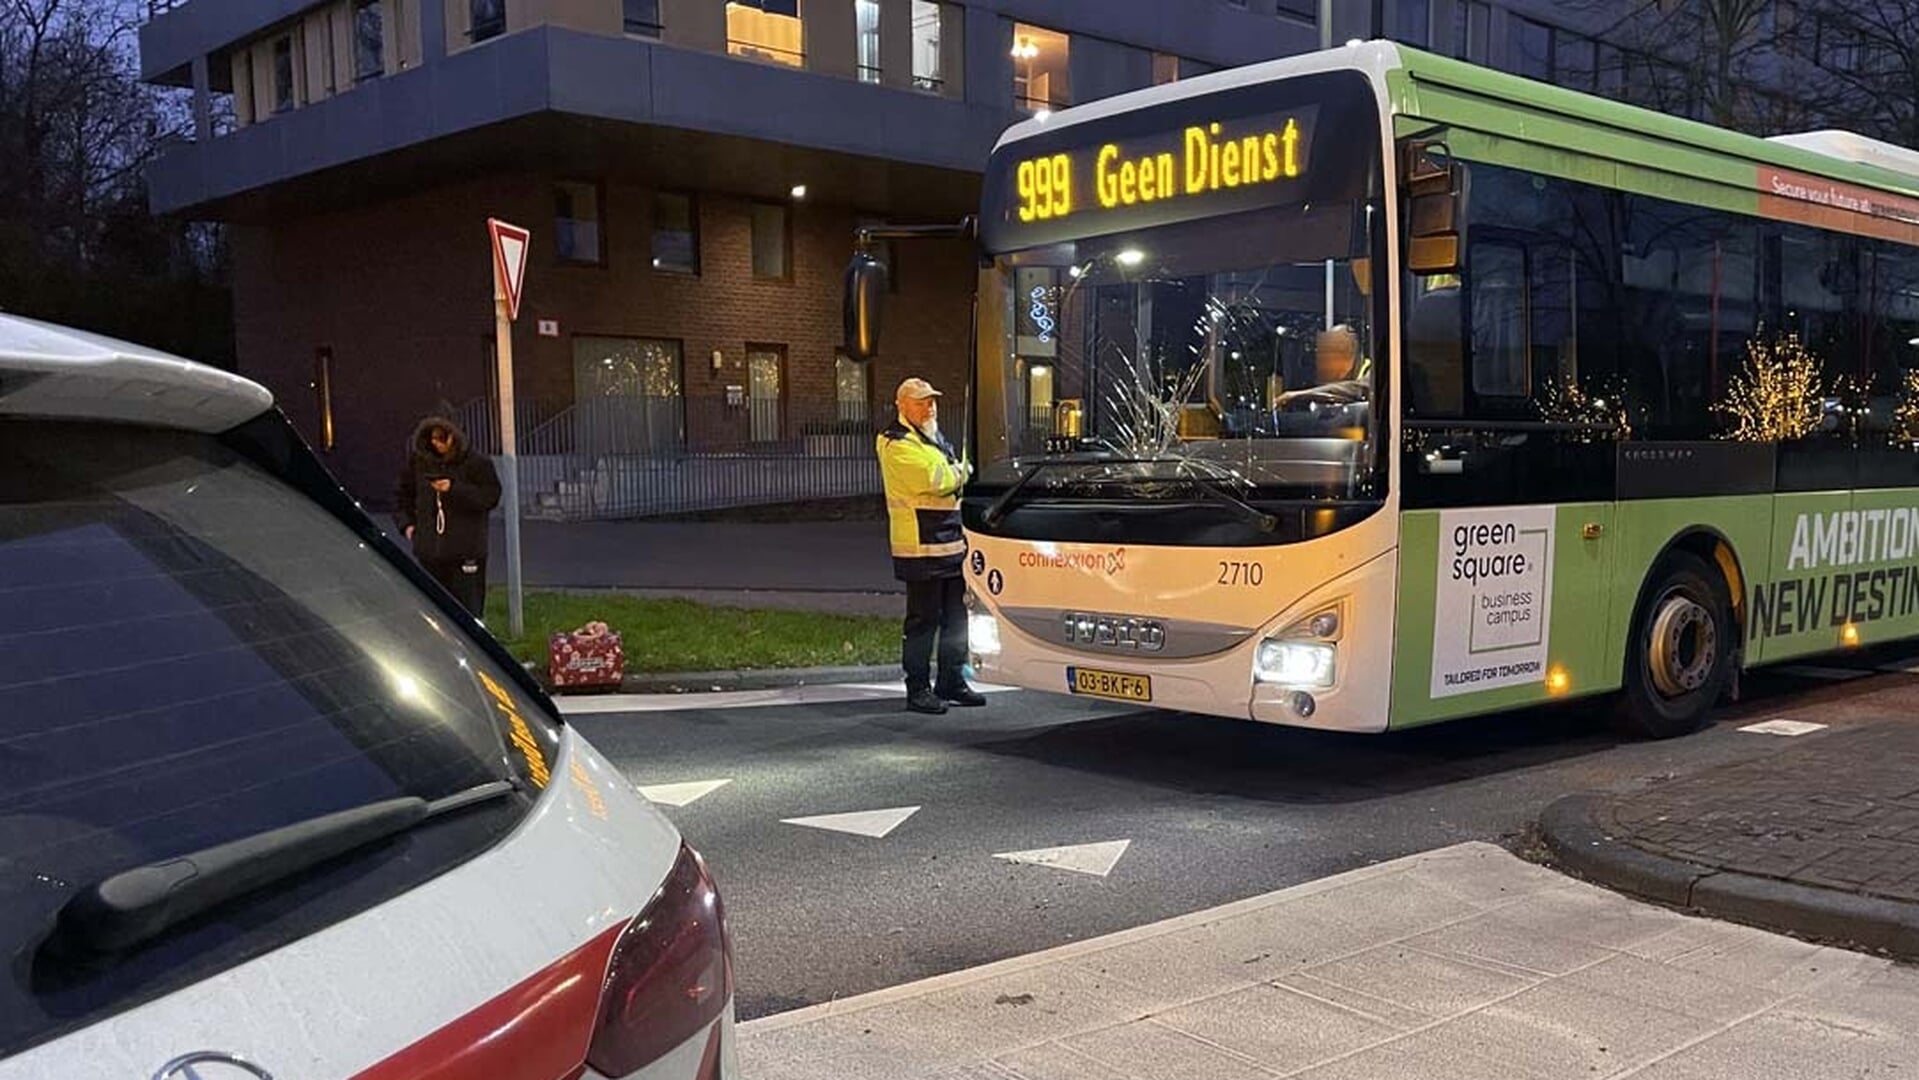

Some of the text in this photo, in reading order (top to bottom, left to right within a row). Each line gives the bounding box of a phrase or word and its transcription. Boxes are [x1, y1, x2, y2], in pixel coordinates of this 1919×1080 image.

[1017, 117, 1299, 222] 999 Geen Dienst
[1771, 175, 1807, 199] Secure
[1453, 522, 1516, 557] green
[1018, 551, 1106, 570] connexxion
[1452, 553, 1526, 587] square
[1217, 561, 1263, 586] 2710
[1481, 590, 1533, 610] business
[1750, 576, 1827, 640] NEW
[1486, 607, 1531, 627] campus
[1079, 671, 1144, 696] 03-BKF-6
[1444, 661, 1541, 686] TAILORED FOR TOMORROW
